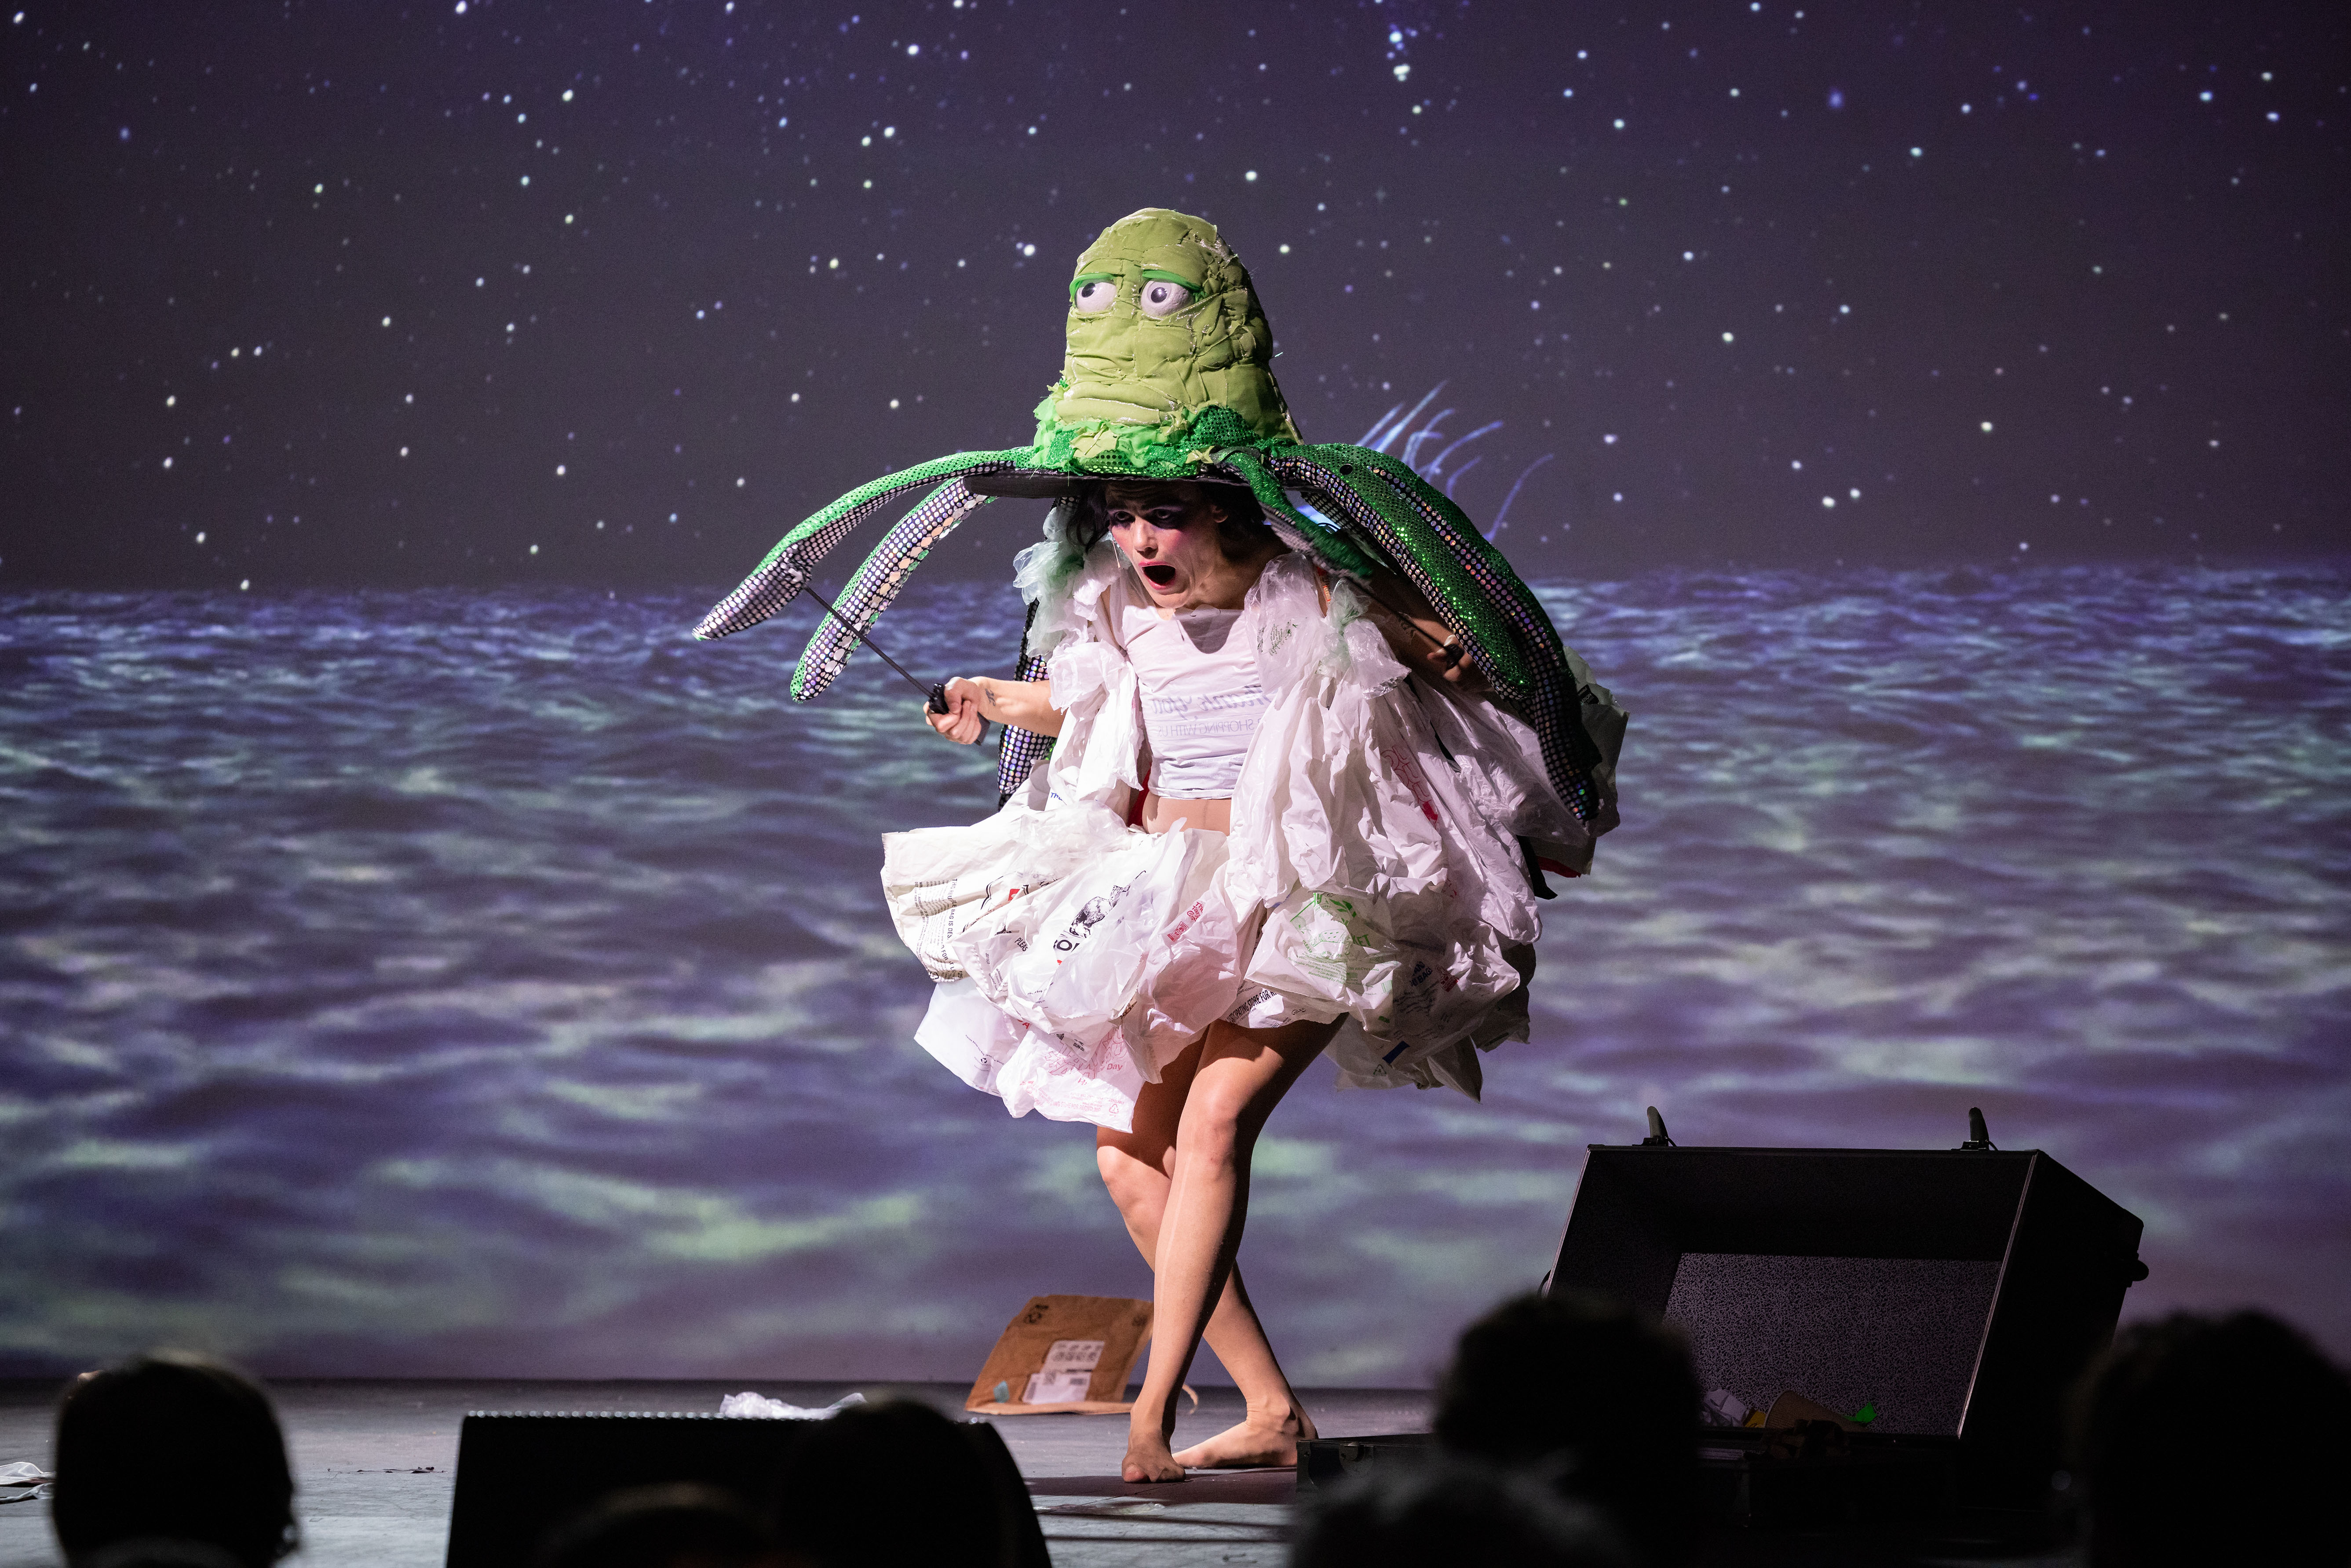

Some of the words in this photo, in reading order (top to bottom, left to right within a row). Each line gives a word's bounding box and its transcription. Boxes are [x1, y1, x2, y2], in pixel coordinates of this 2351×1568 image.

[1302, 940, 1313, 953] PLEASE
[1308, 971, 1331, 981] Manufactured
[1247, 995, 1261, 1009] STORE
[1259, 990, 1271, 1002] FOR
